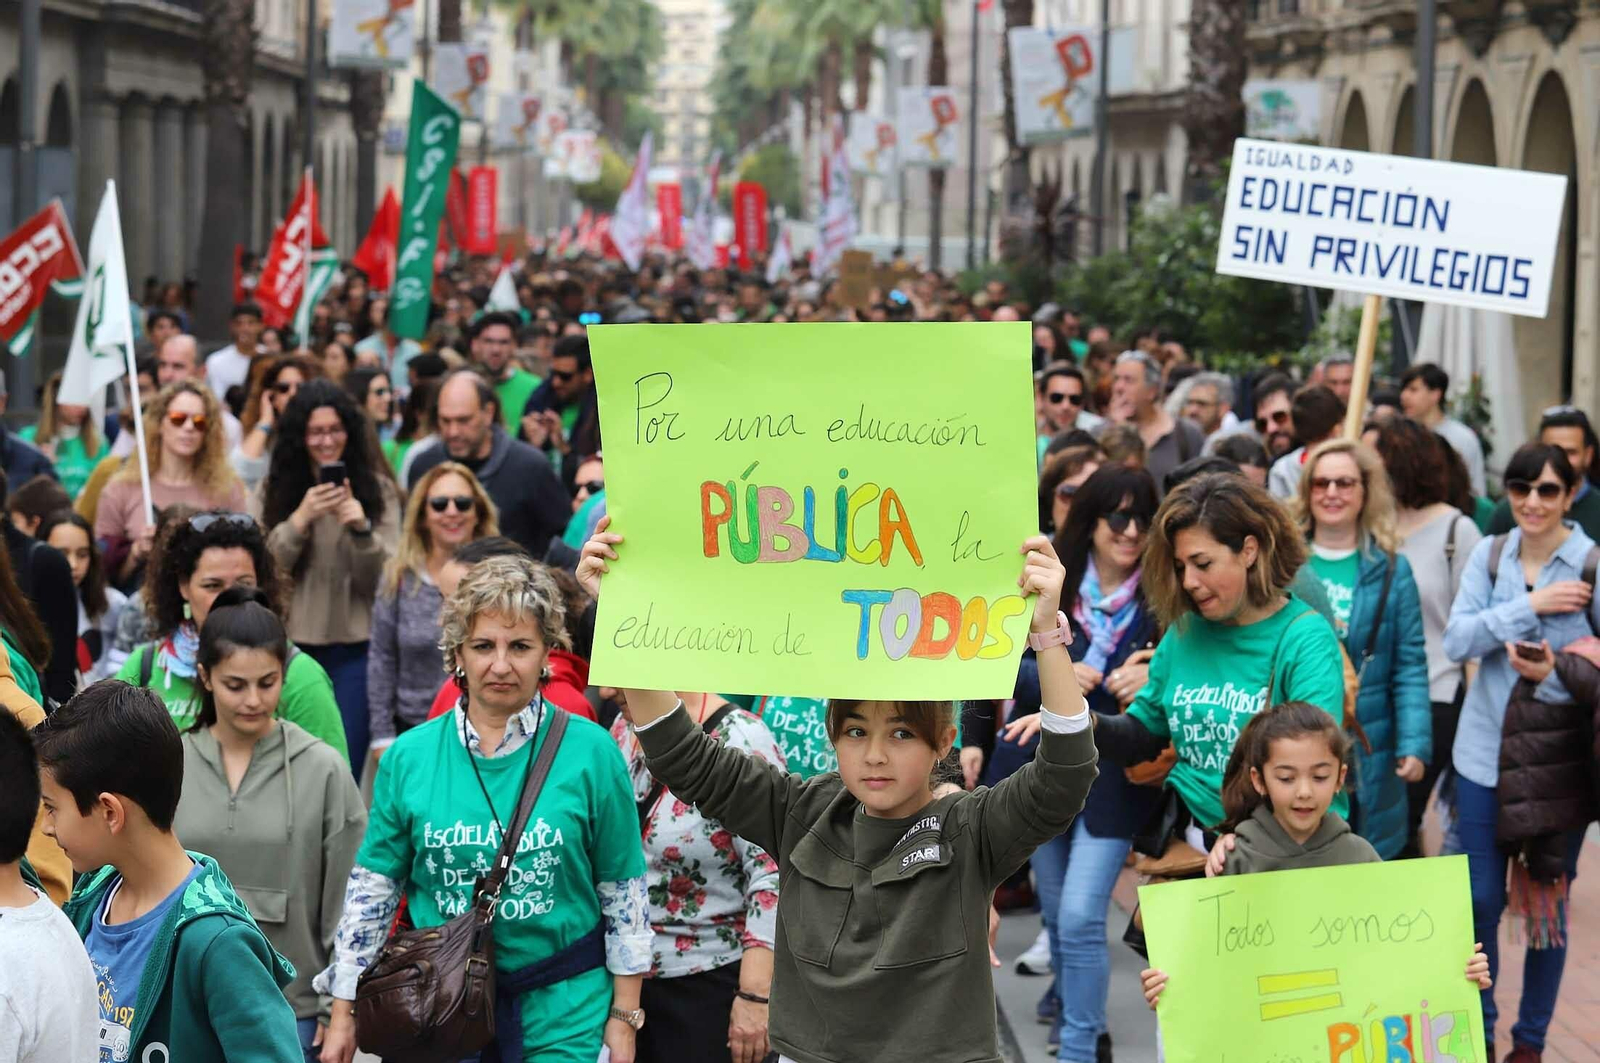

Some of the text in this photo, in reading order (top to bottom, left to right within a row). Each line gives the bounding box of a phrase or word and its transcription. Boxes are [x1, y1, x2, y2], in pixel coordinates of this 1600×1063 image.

[1245, 147, 1356, 175] IGUALDAD
[1239, 177, 1450, 232] EDUCACIÓN
[1232, 225, 1533, 299] SIN PRIVILEGIOS
[634, 371, 986, 447] Por una educación
[951, 510, 1004, 562] la
[772, 612, 812, 656] de
[841, 587, 1027, 661] TODOS
[424, 820, 498, 849] ESCUELA
[902, 847, 935, 867] STAR
[1198, 889, 1435, 956] Todos somos
